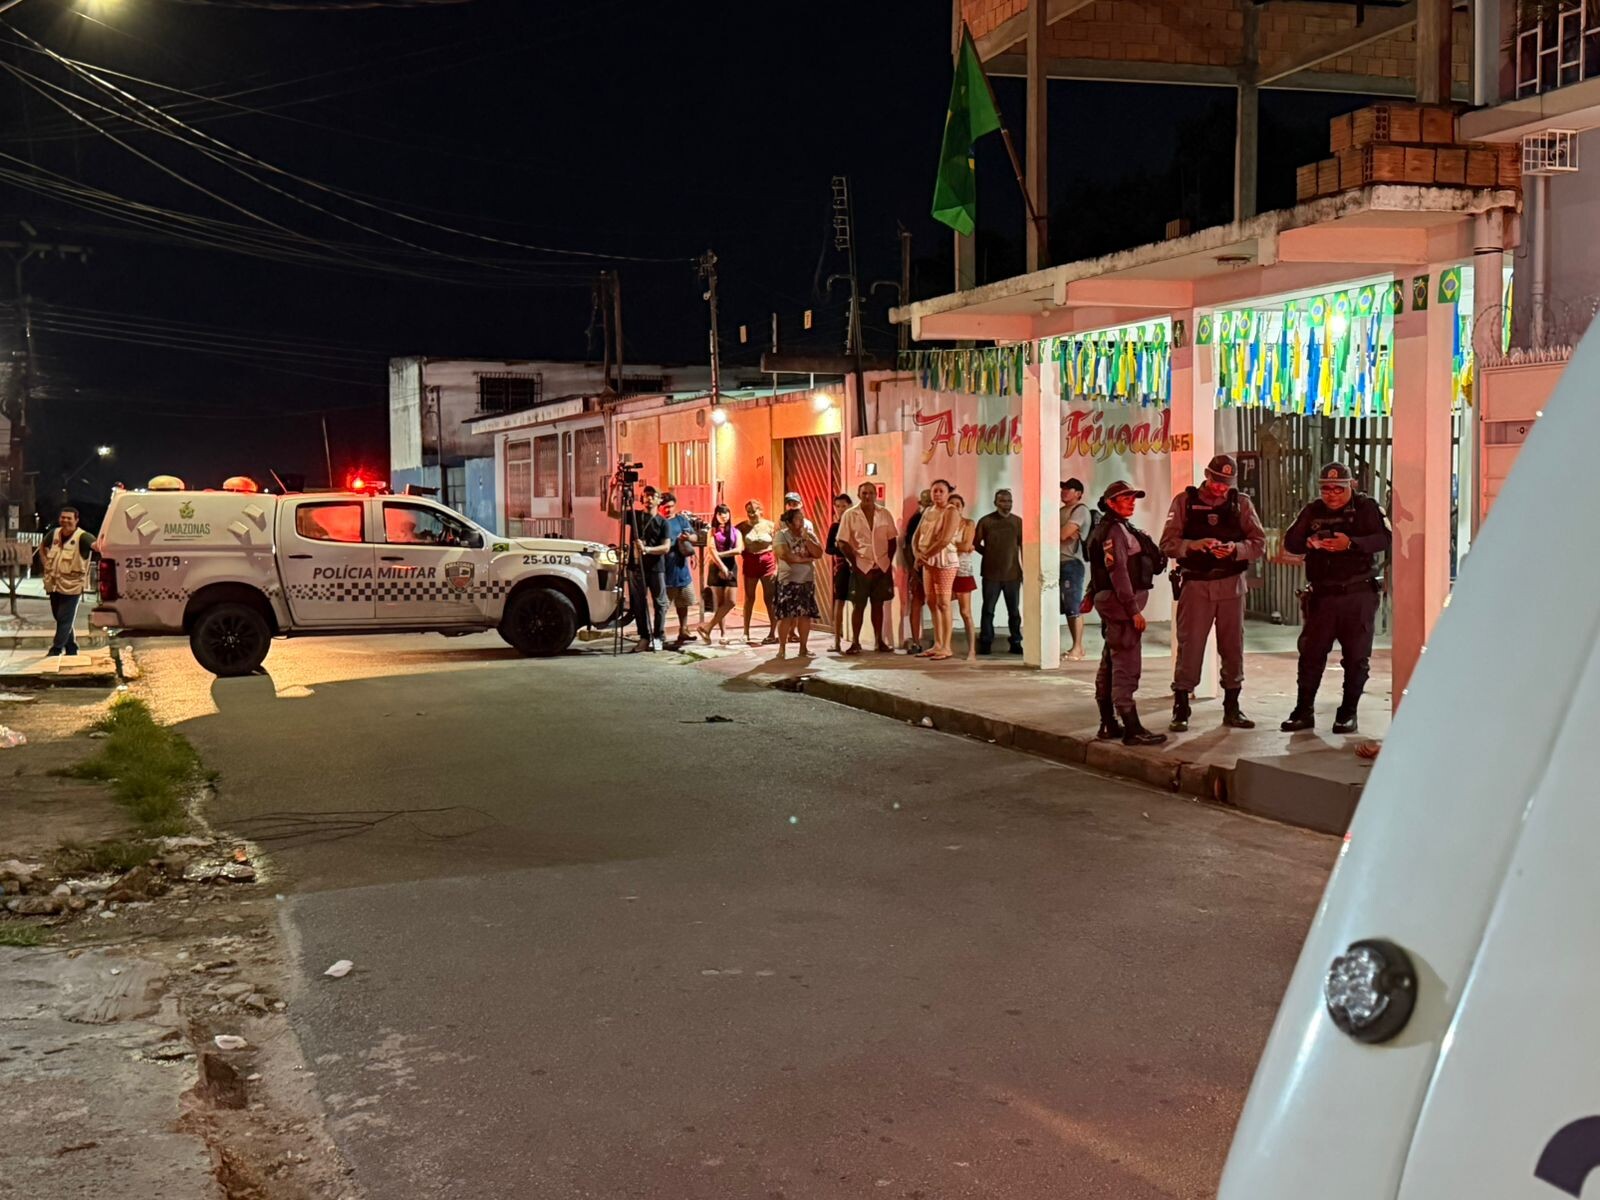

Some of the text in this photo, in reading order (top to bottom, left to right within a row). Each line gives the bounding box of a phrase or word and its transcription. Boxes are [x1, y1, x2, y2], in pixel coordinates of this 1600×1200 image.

[1060, 408, 1171, 463] Feijoad
[163, 523, 211, 535] AMAZONAS
[125, 556, 180, 568] 25-1079
[523, 554, 571, 565] 25-1079
[139, 571, 160, 581] 190
[313, 565, 436, 579] POLÍCIA MILITAR
